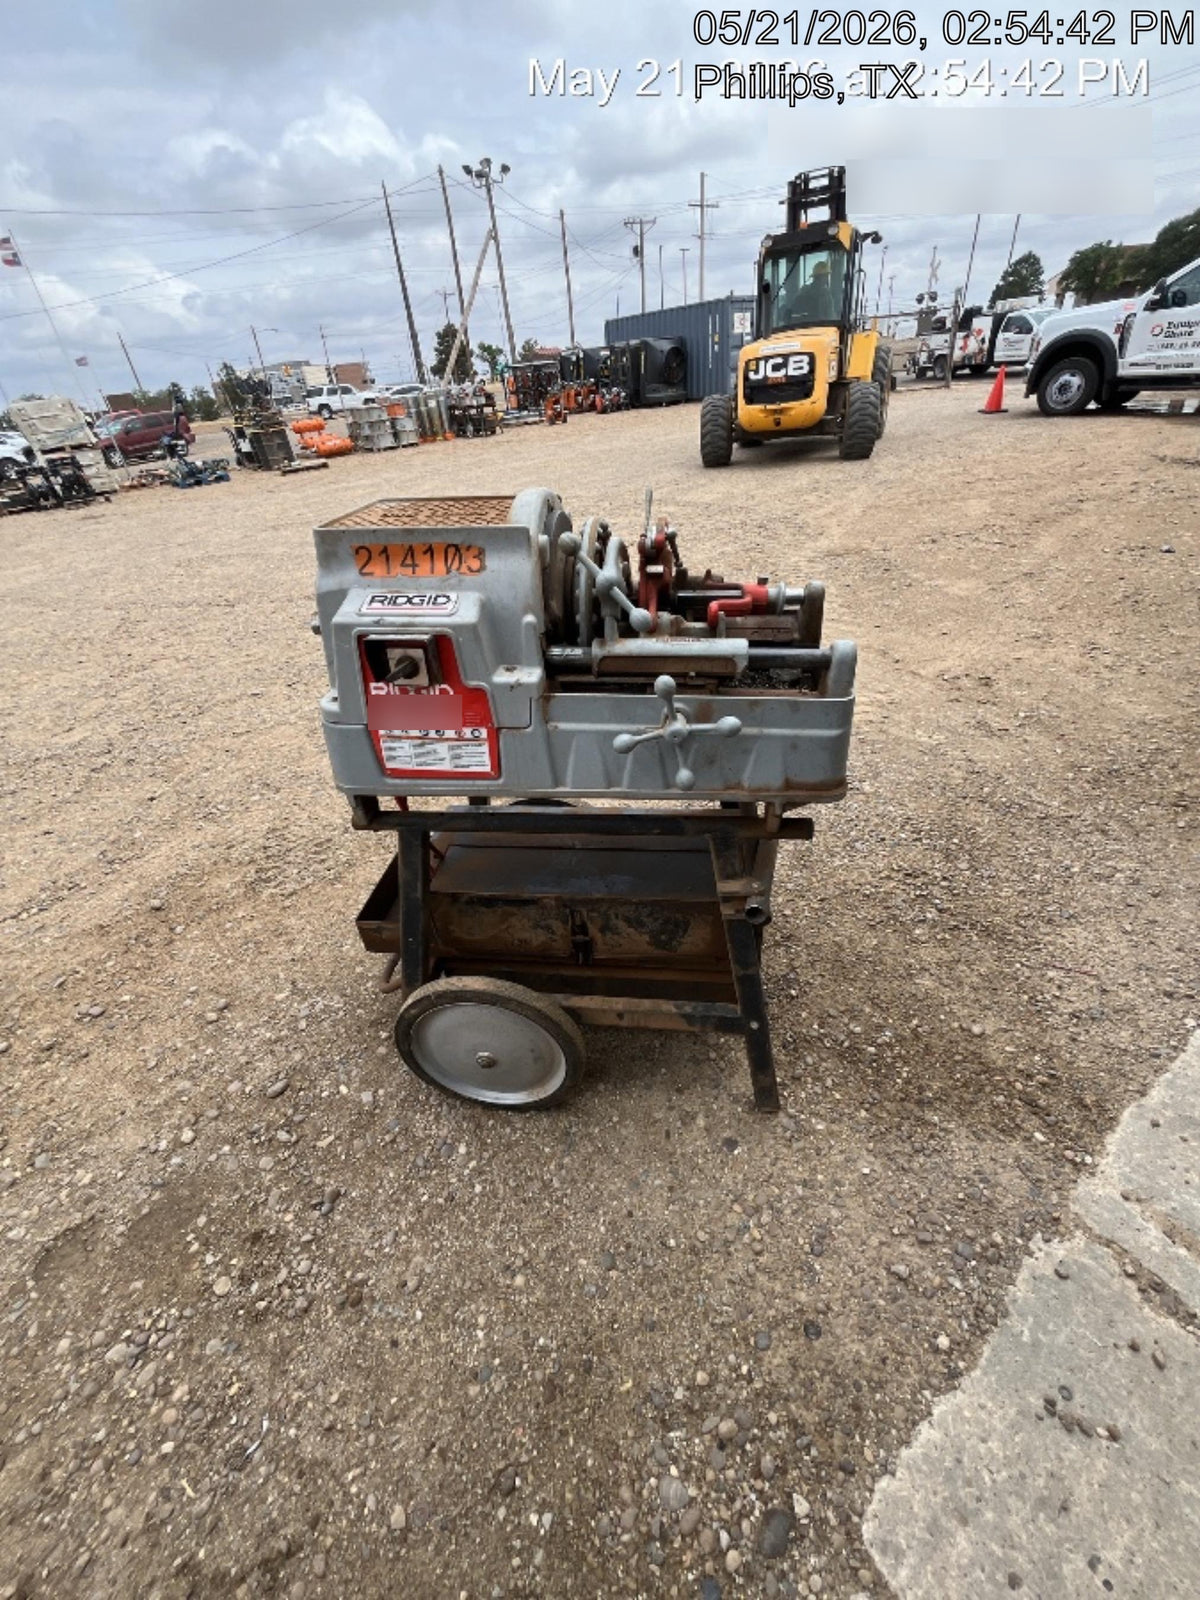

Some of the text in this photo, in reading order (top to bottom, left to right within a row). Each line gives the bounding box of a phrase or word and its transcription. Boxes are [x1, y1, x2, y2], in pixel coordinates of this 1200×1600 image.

[747, 355, 810, 380] JCB
[355, 543, 485, 577] 214103
[368, 593, 452, 607] RIDGID
